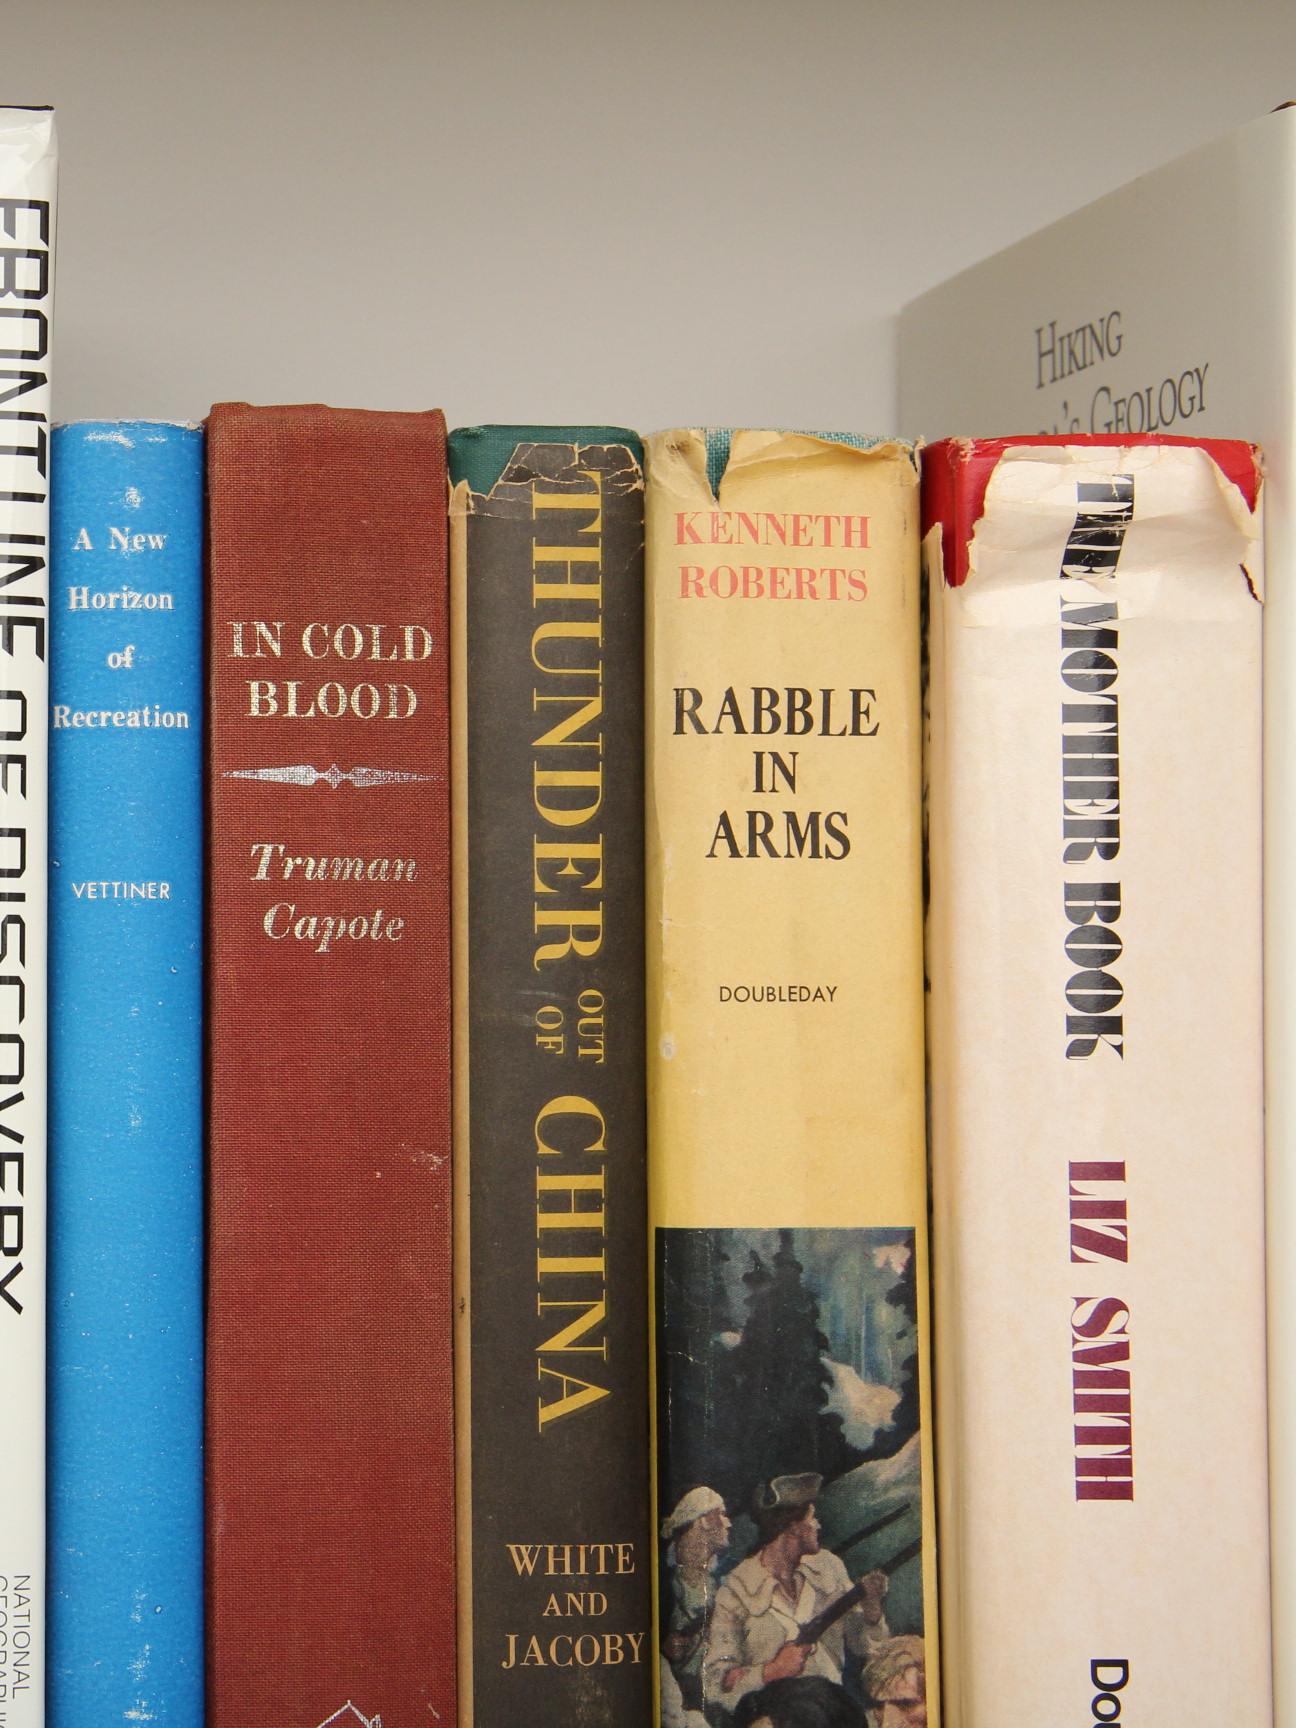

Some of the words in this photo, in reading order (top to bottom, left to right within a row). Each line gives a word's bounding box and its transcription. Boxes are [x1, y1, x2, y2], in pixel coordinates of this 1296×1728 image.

[73, 527, 94, 551] A
[108, 527, 167, 552] New
[674, 511, 871, 549] KENNETH
[1060, 474, 1135, 579] THE
[68, 585, 173, 611] Horizon
[678, 565, 868, 602] ROBERTS
[107, 645, 134, 669] of
[227, 621, 285, 658] IN
[302, 623, 433, 661] COLD
[53, 705, 190, 730] Recreation
[245, 680, 418, 719] BLOOD
[673, 686, 879, 737] RABBLE
[531, 470, 603, 973] THUNDER
[1060, 594, 1121, 865] MOTHER
[752, 751, 798, 793] IN
[706, 810, 851, 861] ARMS
[250, 844, 418, 882] Truman
[72, 881, 171, 900] VETTINER
[263, 902, 404, 953] Capote
[1064, 881, 1124, 1060] BOOK
[719, 986, 838, 1003] DOUBLEDAY
[535, 1006, 564, 1054] OF
[577, 989, 605, 1063] OUT
[1068, 1160, 1128, 1263] LIZ
[534, 1095, 610, 1433] CHINA
[1070, 1296, 1134, 1502] SMITH
[506, 1543, 635, 1576] WHITE
[542, 1592, 608, 1616] AND
[13, 1575, 31, 1699] NATIONAL
[501, 1632, 645, 1669] JACOBY
